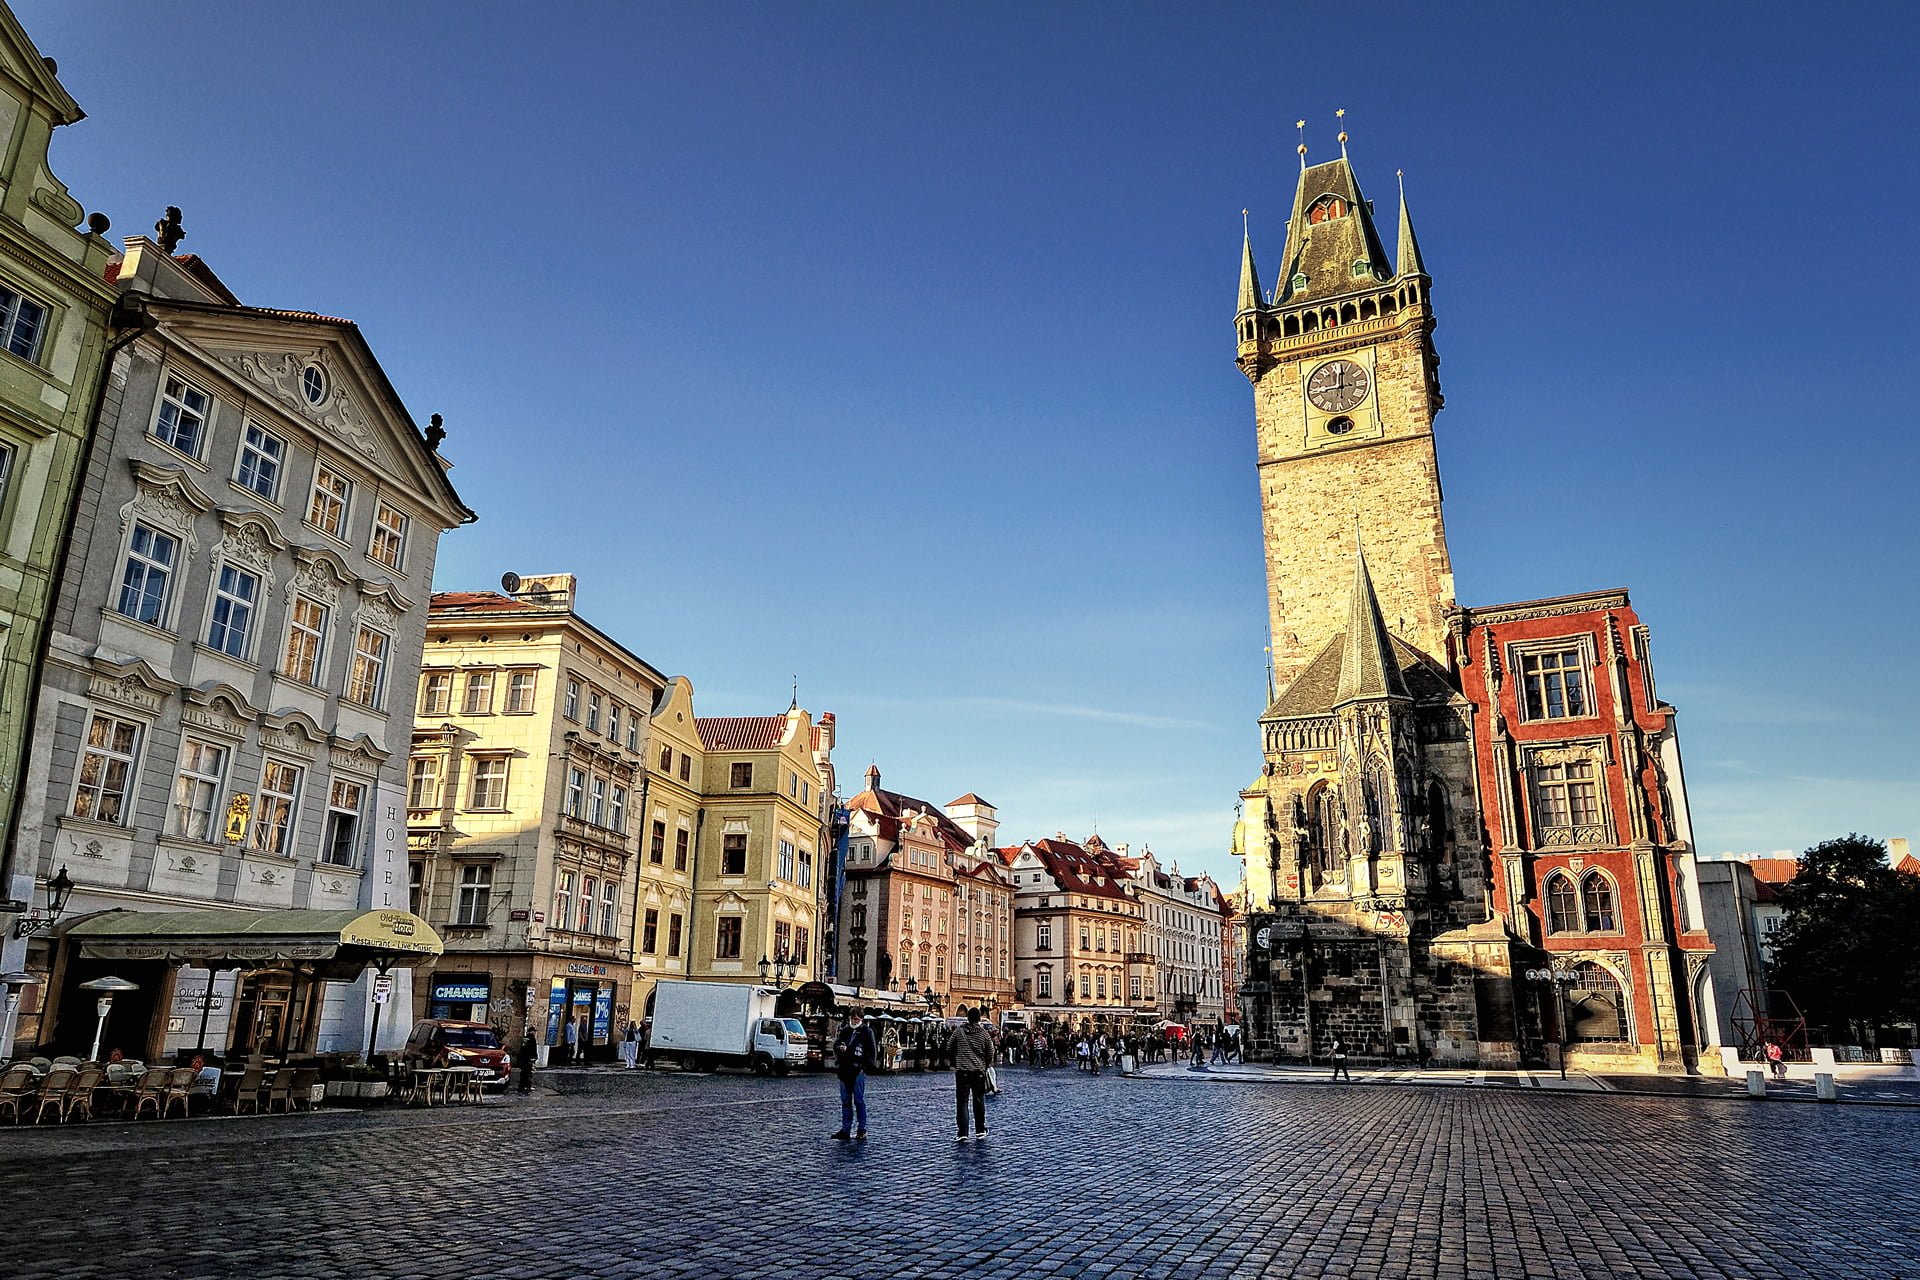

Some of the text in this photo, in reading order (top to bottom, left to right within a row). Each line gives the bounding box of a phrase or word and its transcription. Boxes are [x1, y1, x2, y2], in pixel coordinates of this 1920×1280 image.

[383, 806, 397, 906] HOTEL
[380, 912, 393, 922] Old
[393, 922, 415, 935] Hotel
[351, 934, 391, 948] Restaurant
[397, 941, 411, 950] Live
[412, 942, 433, 953] Music
[180, 988, 195, 998] Old
[435, 987, 489, 999] CHANGE
